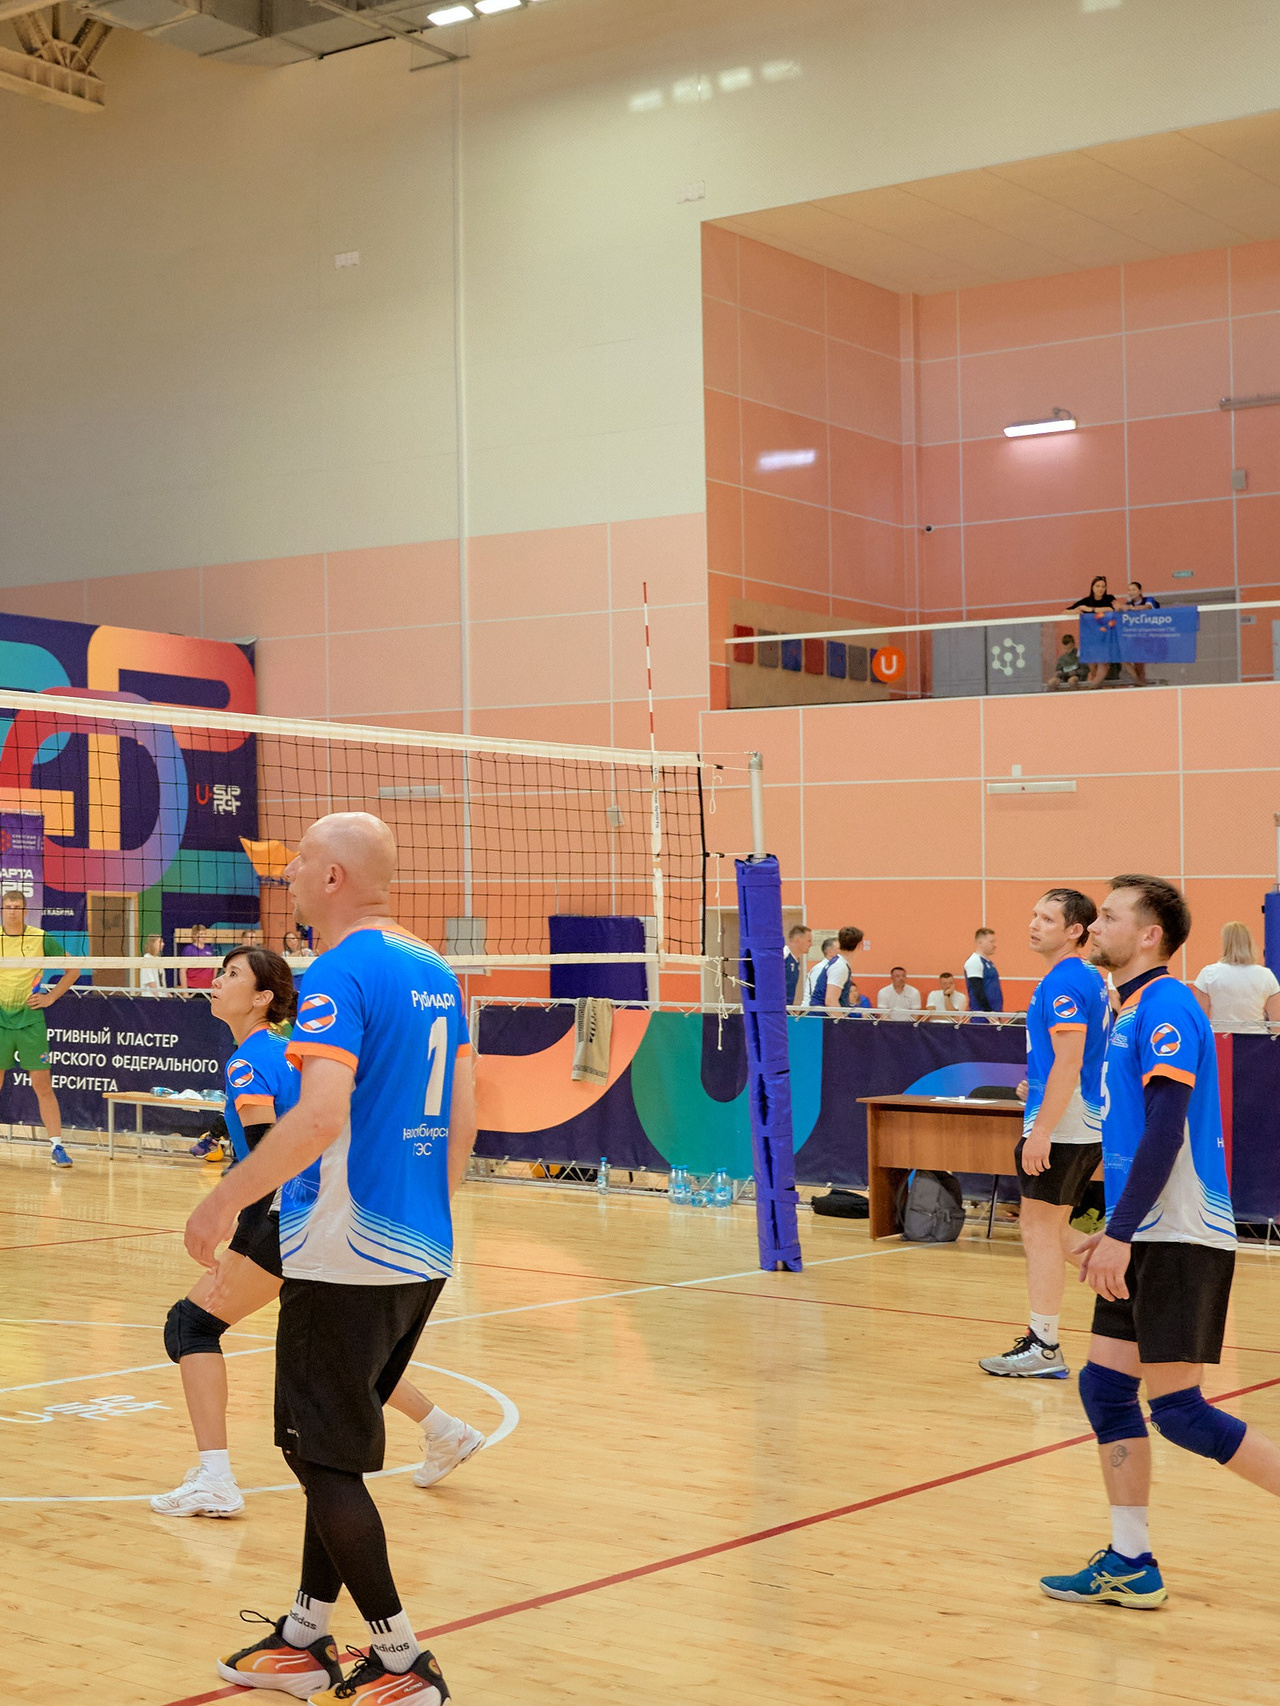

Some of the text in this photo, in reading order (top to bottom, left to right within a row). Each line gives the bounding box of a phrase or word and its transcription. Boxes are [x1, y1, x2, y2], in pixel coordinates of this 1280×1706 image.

[1122, 614, 1172, 626] РусГидро
[881, 655, 897, 674] U
[116, 1031, 179, 1048] КЛАСТЕР
[111, 1054, 219, 1074] ФЕДЕРАЛЬНОГО
[423, 1016, 448, 1117] 1
[374, 1642, 410, 1653] adidas
